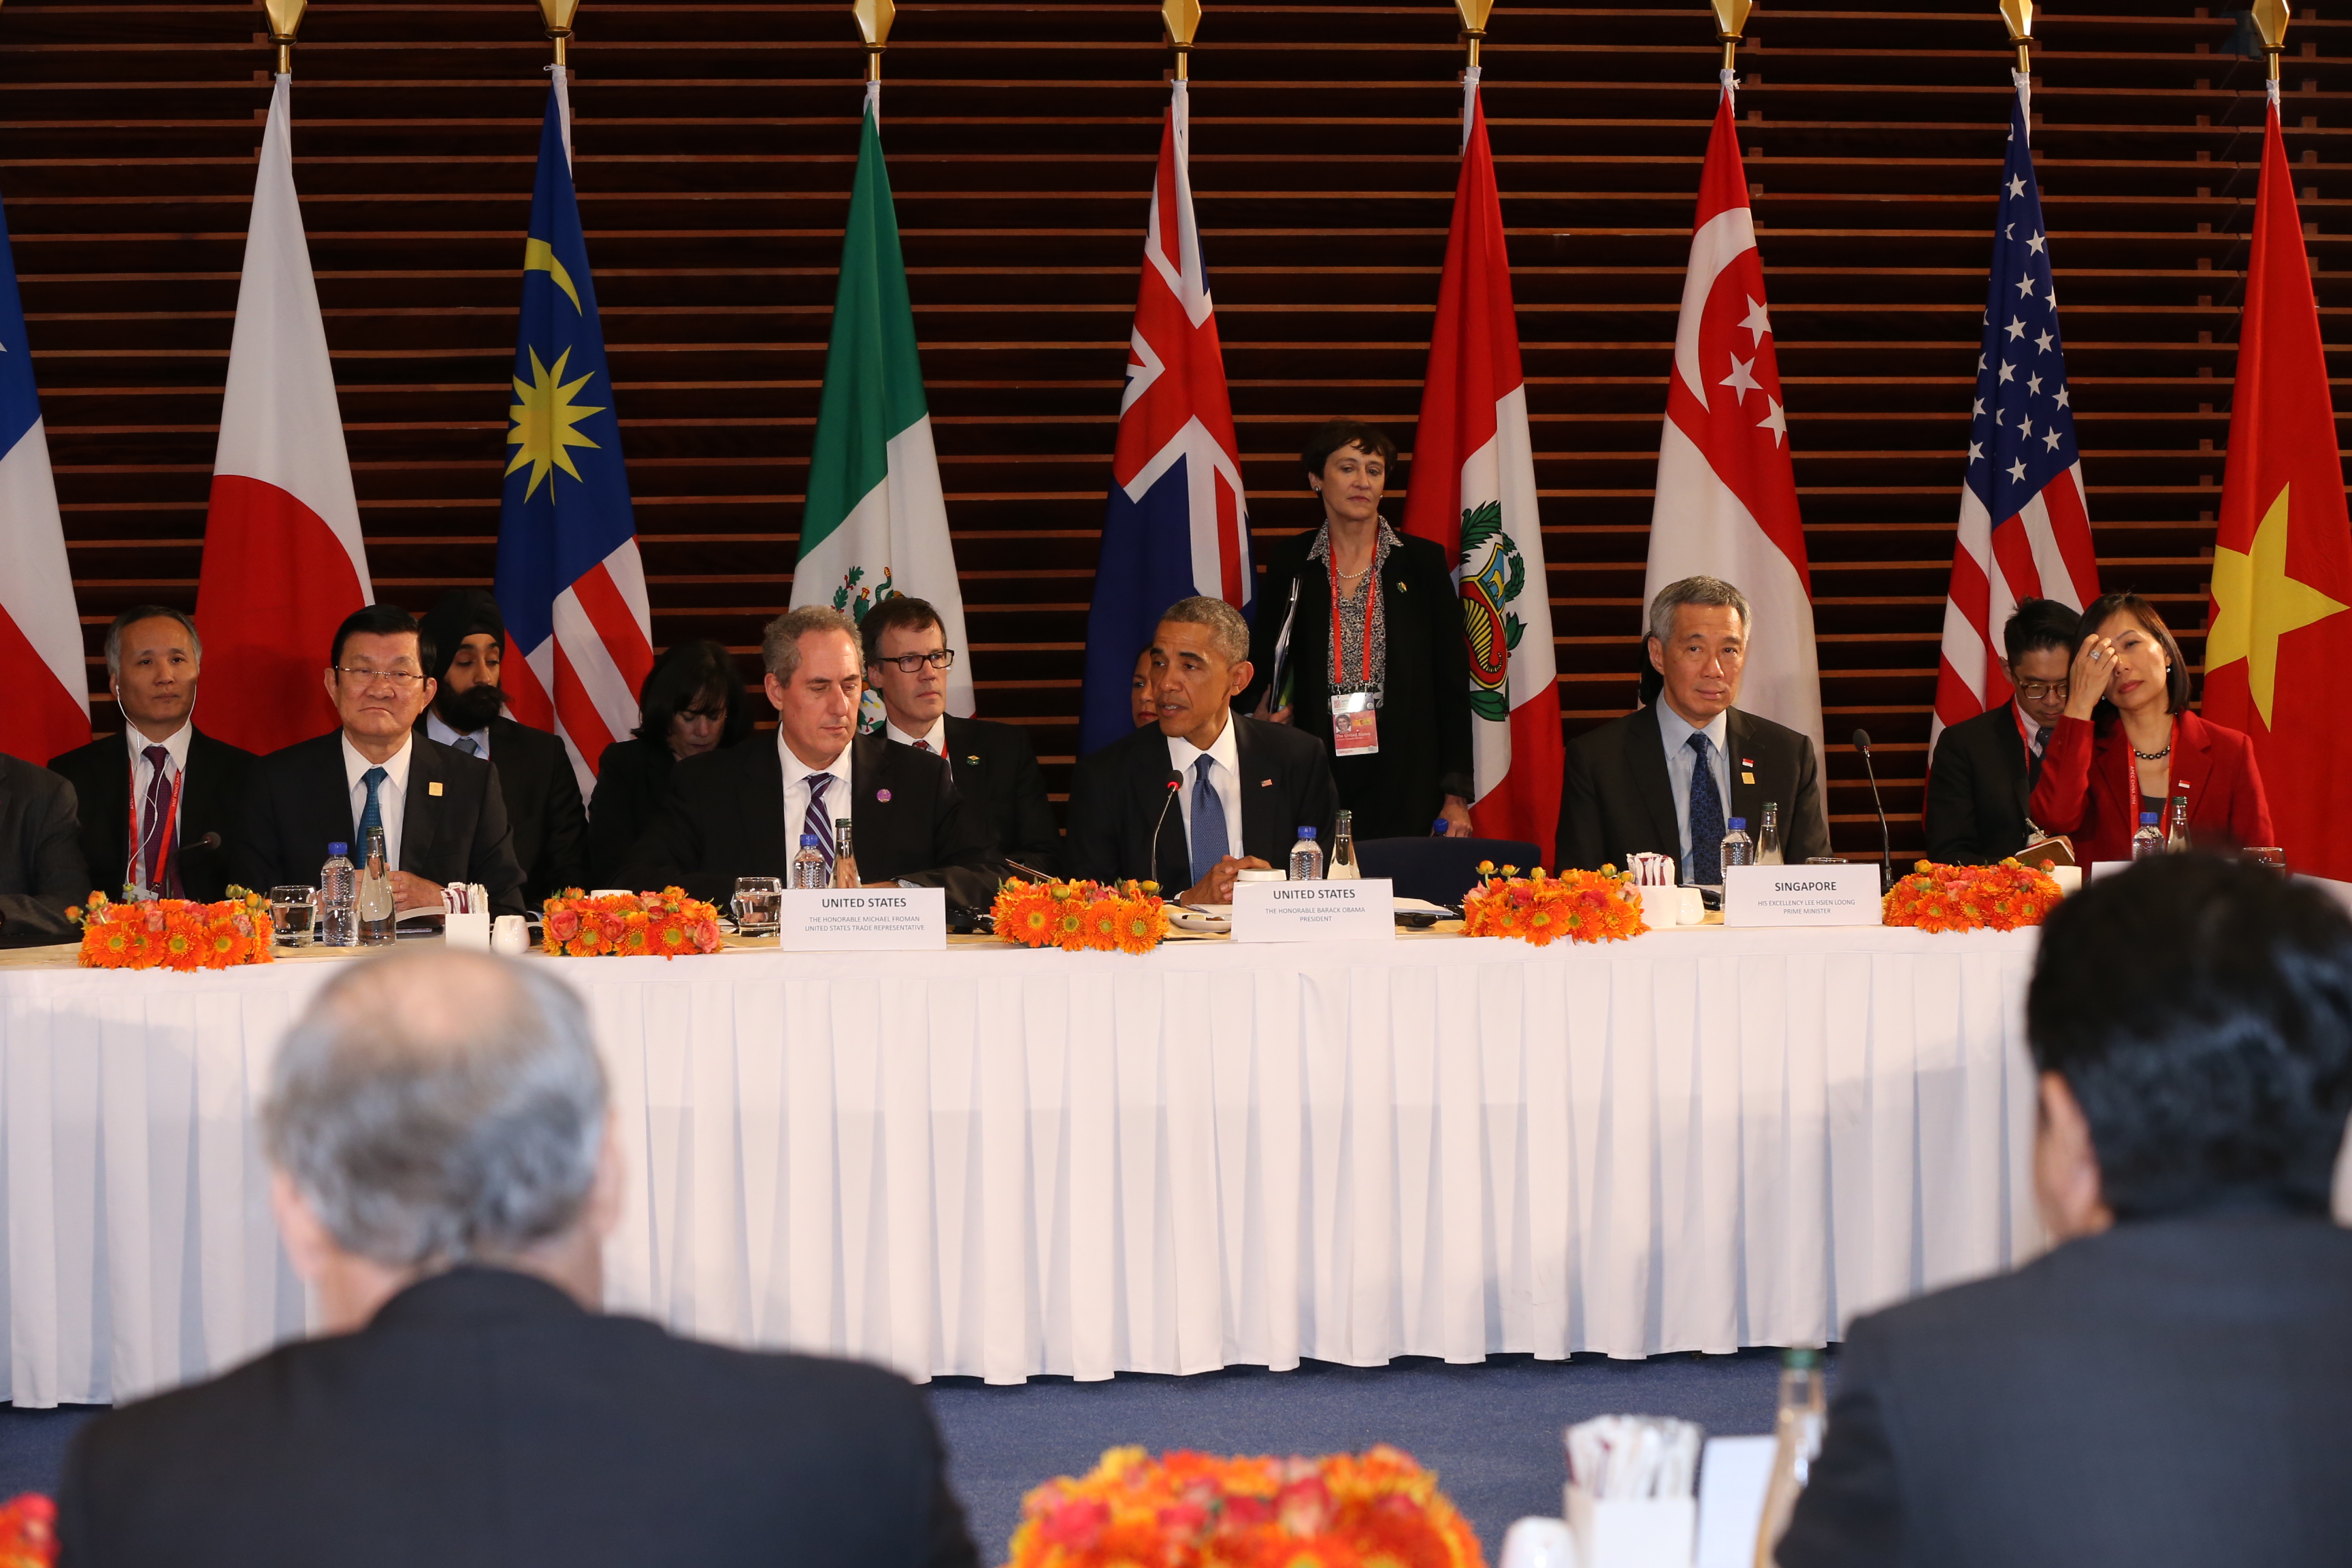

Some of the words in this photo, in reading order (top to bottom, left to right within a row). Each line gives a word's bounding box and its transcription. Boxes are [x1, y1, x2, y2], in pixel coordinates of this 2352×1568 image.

[1775, 882, 1836, 891] SINGAPORE
[1273, 890, 1314, 899] UNITED
[1318, 889, 1355, 898] STATES
[822, 898, 864, 907] UNITED
[868, 898, 906, 907] STATES
